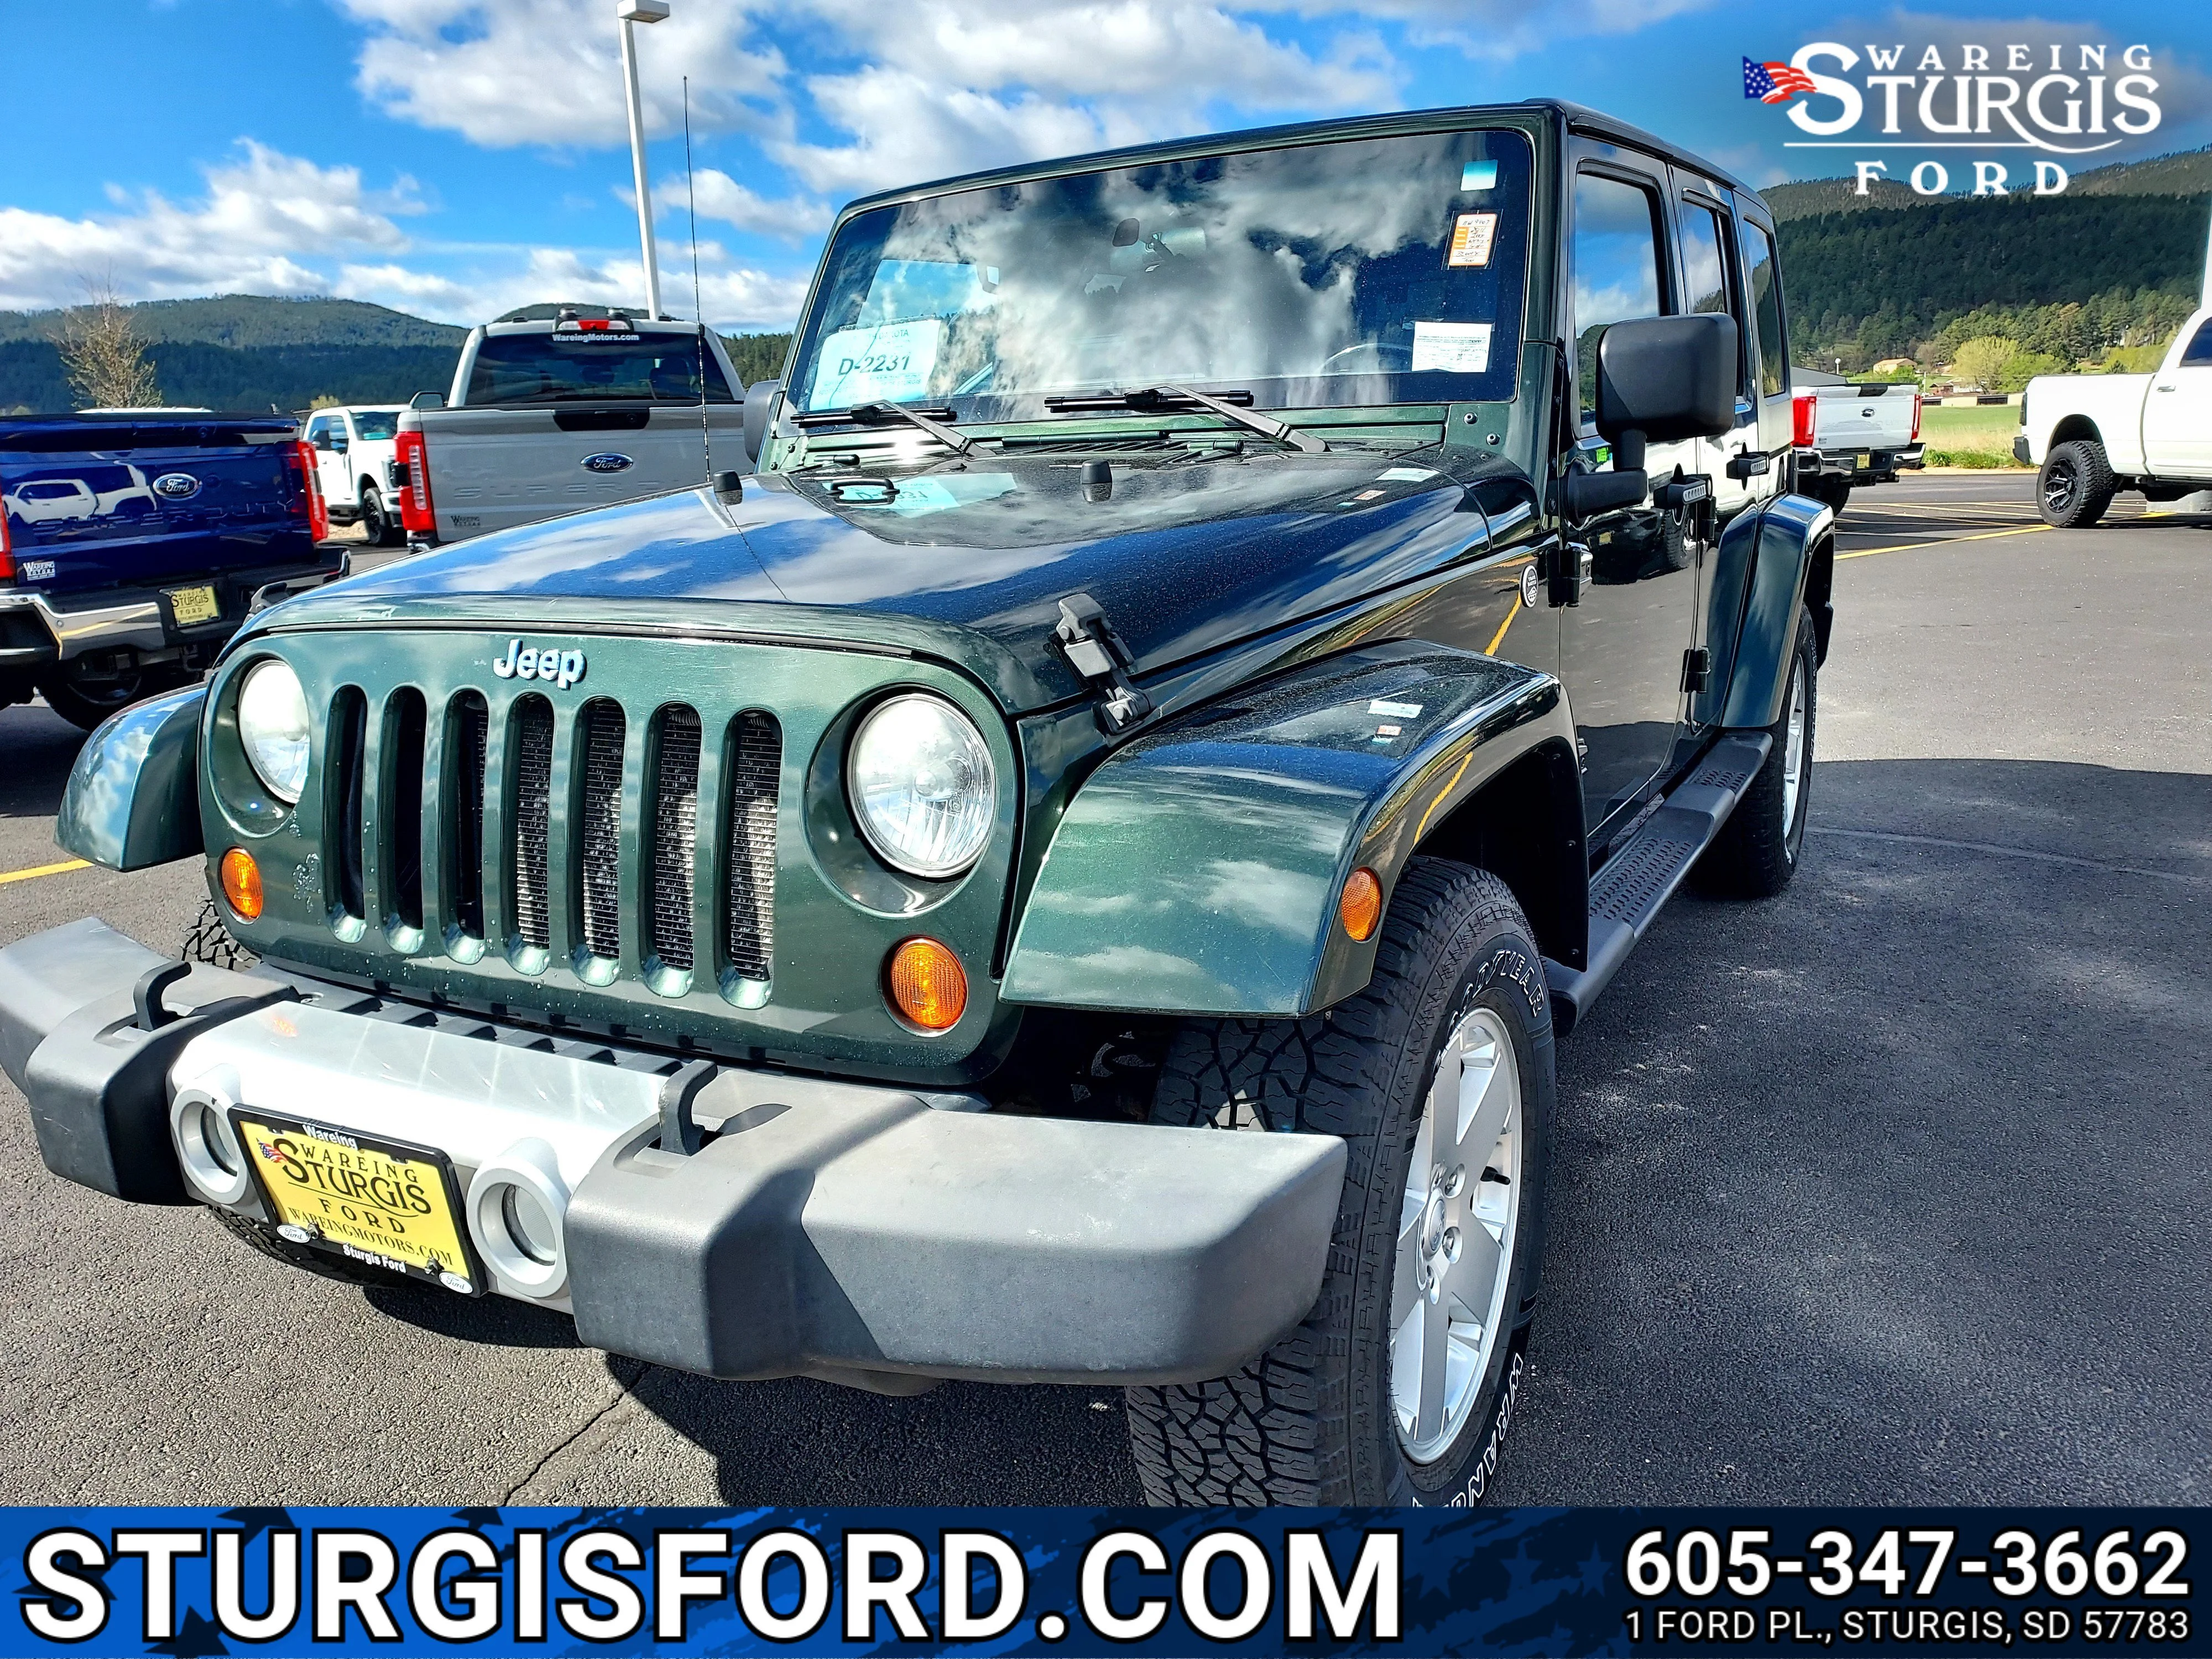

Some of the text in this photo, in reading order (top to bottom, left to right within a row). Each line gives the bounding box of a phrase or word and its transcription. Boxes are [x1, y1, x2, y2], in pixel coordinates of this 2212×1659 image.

[552, 333, 640, 342] WareingMotors.com
[838, 354, 910, 376] D-2231
[593, 456, 621, 469] Ford
[166, 478, 190, 492] Ford
[171, 594, 209, 607] STURGIS
[493, 639, 587, 691] Jeep
[302, 1124, 359, 1150] Wareing
[273, 1138, 431, 1215] STURGIS
[300, 1143, 418, 1183] WAREING
[318, 1198, 405, 1233] FORD
[288, 1207, 454, 1266] WAREINGMOTORS.COM
[342, 1243, 407, 1273] Sturgis Ford
